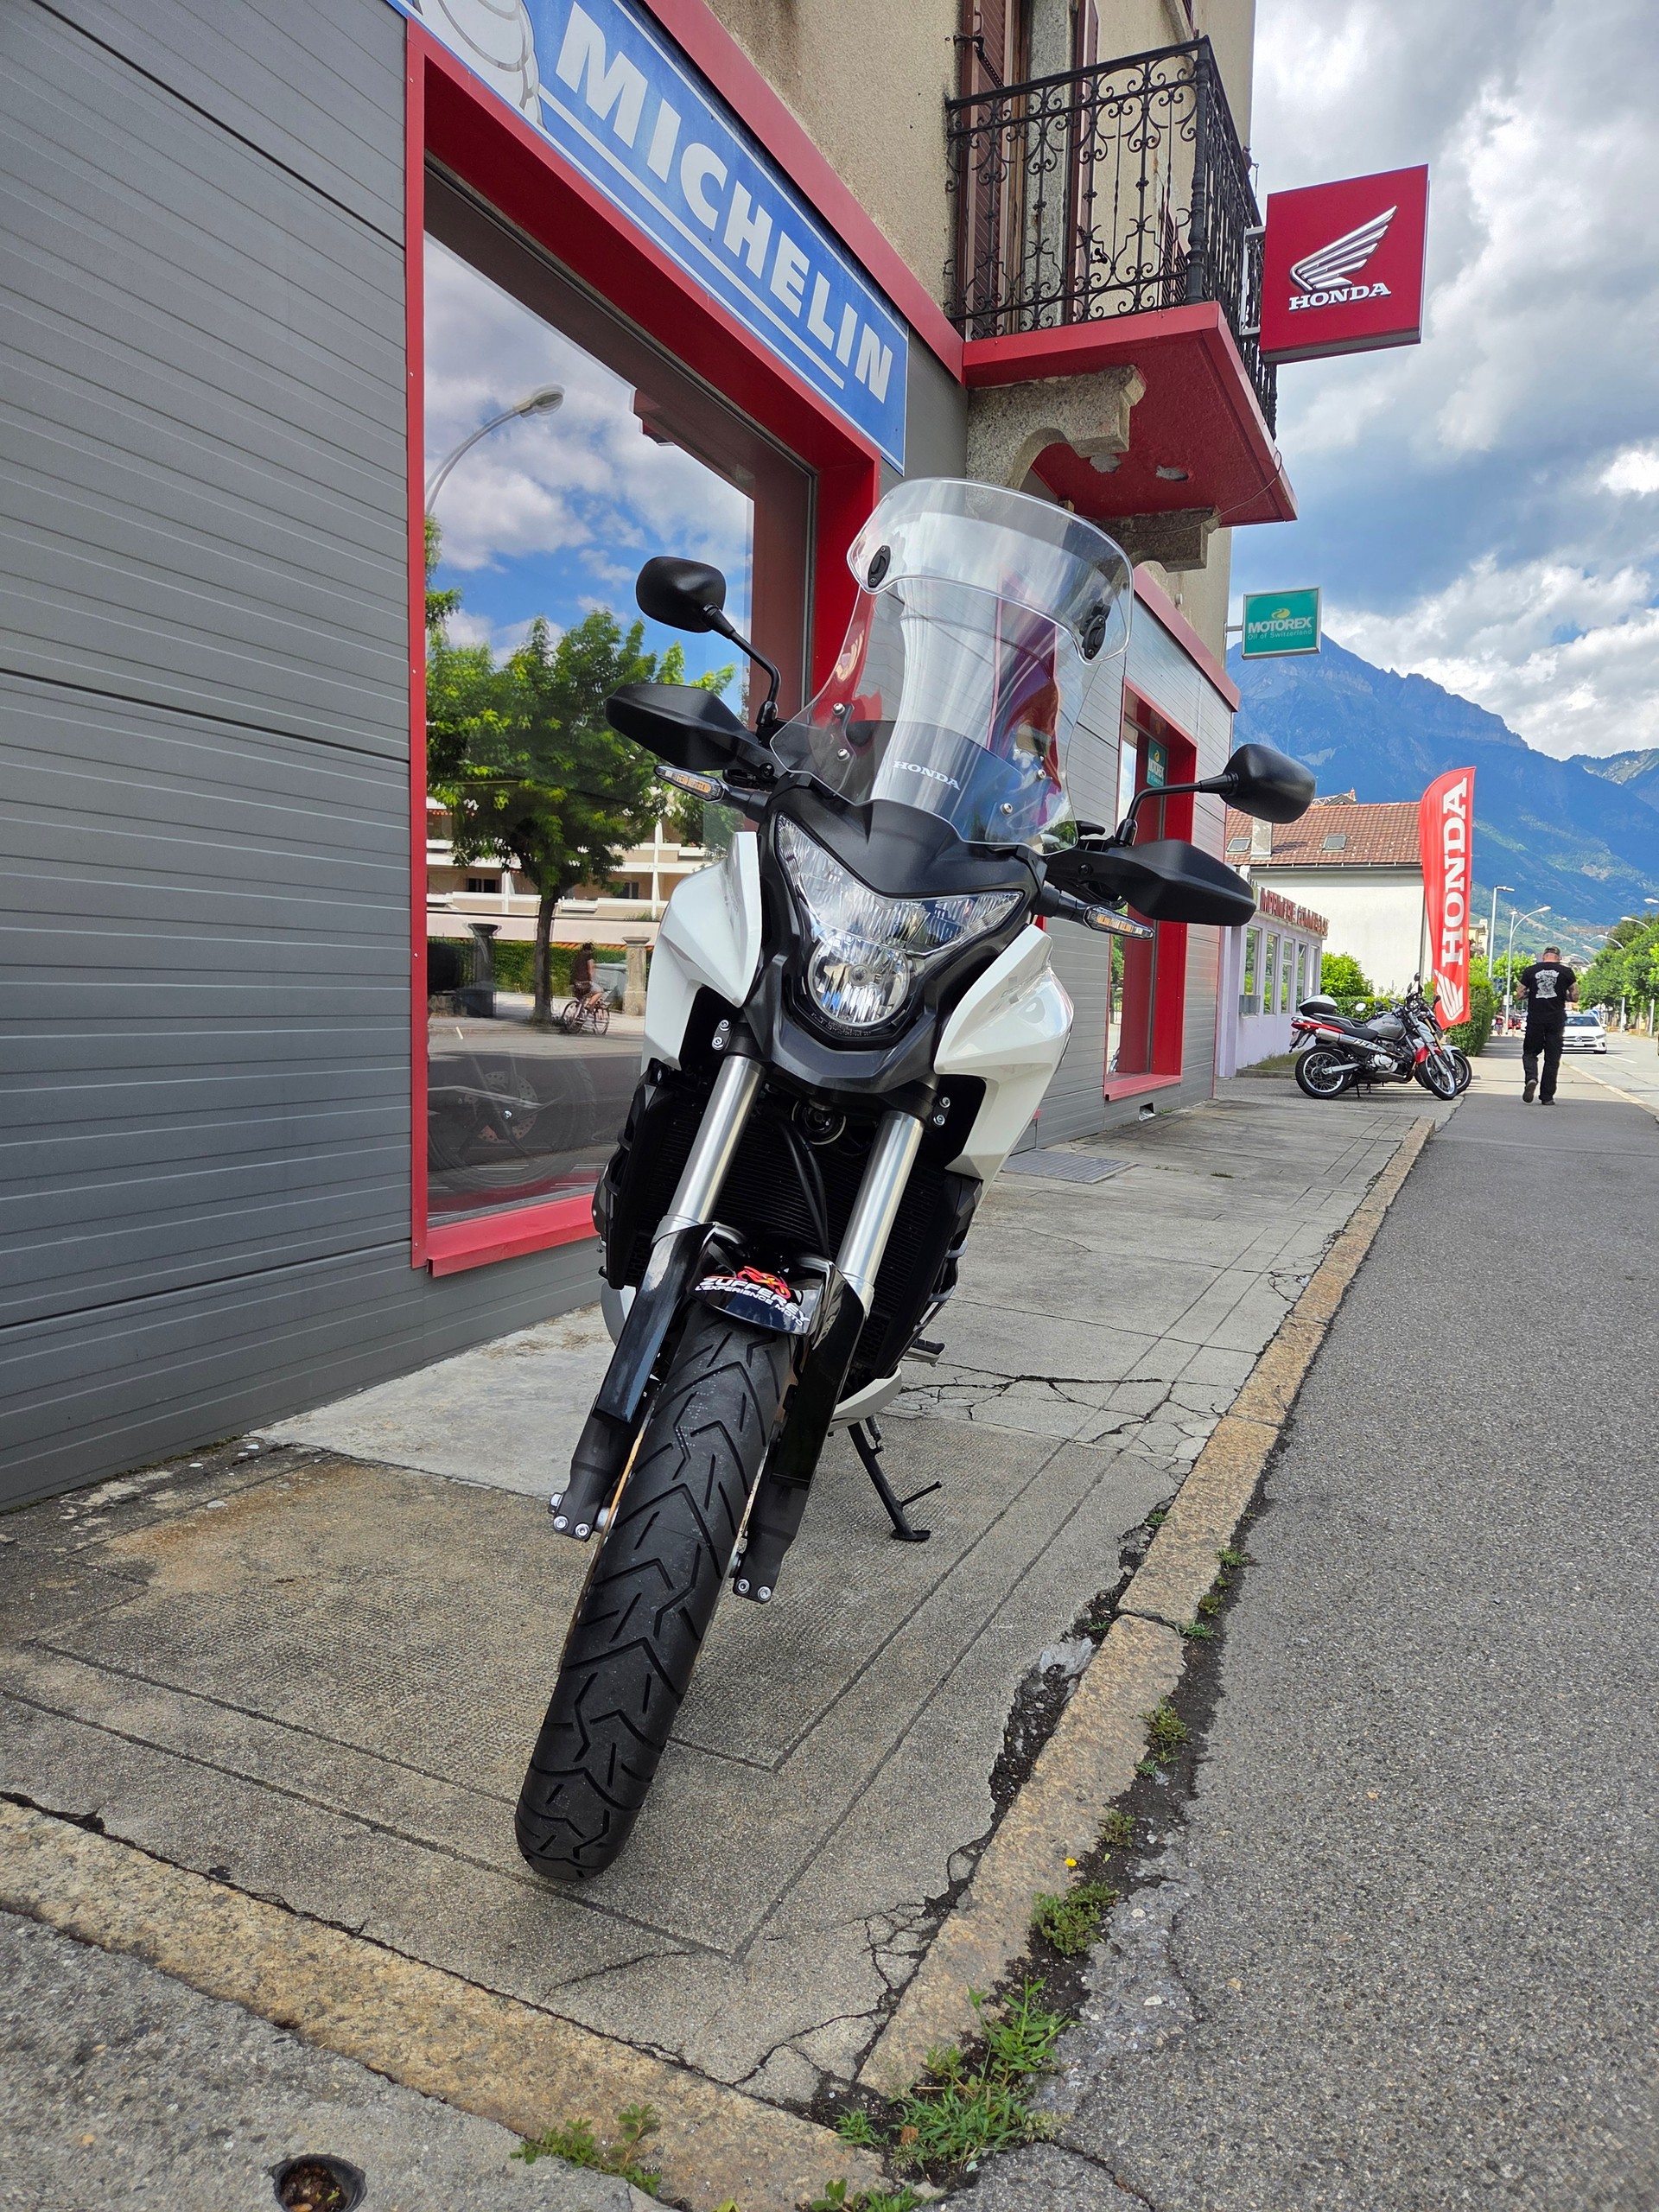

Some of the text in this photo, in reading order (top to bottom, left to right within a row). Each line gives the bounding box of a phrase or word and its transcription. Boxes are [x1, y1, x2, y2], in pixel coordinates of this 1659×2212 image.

[555, 1, 893, 404] MICHELIN
[1288, 283, 1391, 311] HONDA
[1248, 617, 1313, 634] MOTOREX
[1270, 629, 1313, 639] Switzerland
[893, 760, 961, 791] HONDA
[1442, 777, 1467, 967] HONDA
[695, 1285, 804, 1326] L'EXPERIENCE MOTO
[699, 1278, 810, 1322] ZUFFEREY
